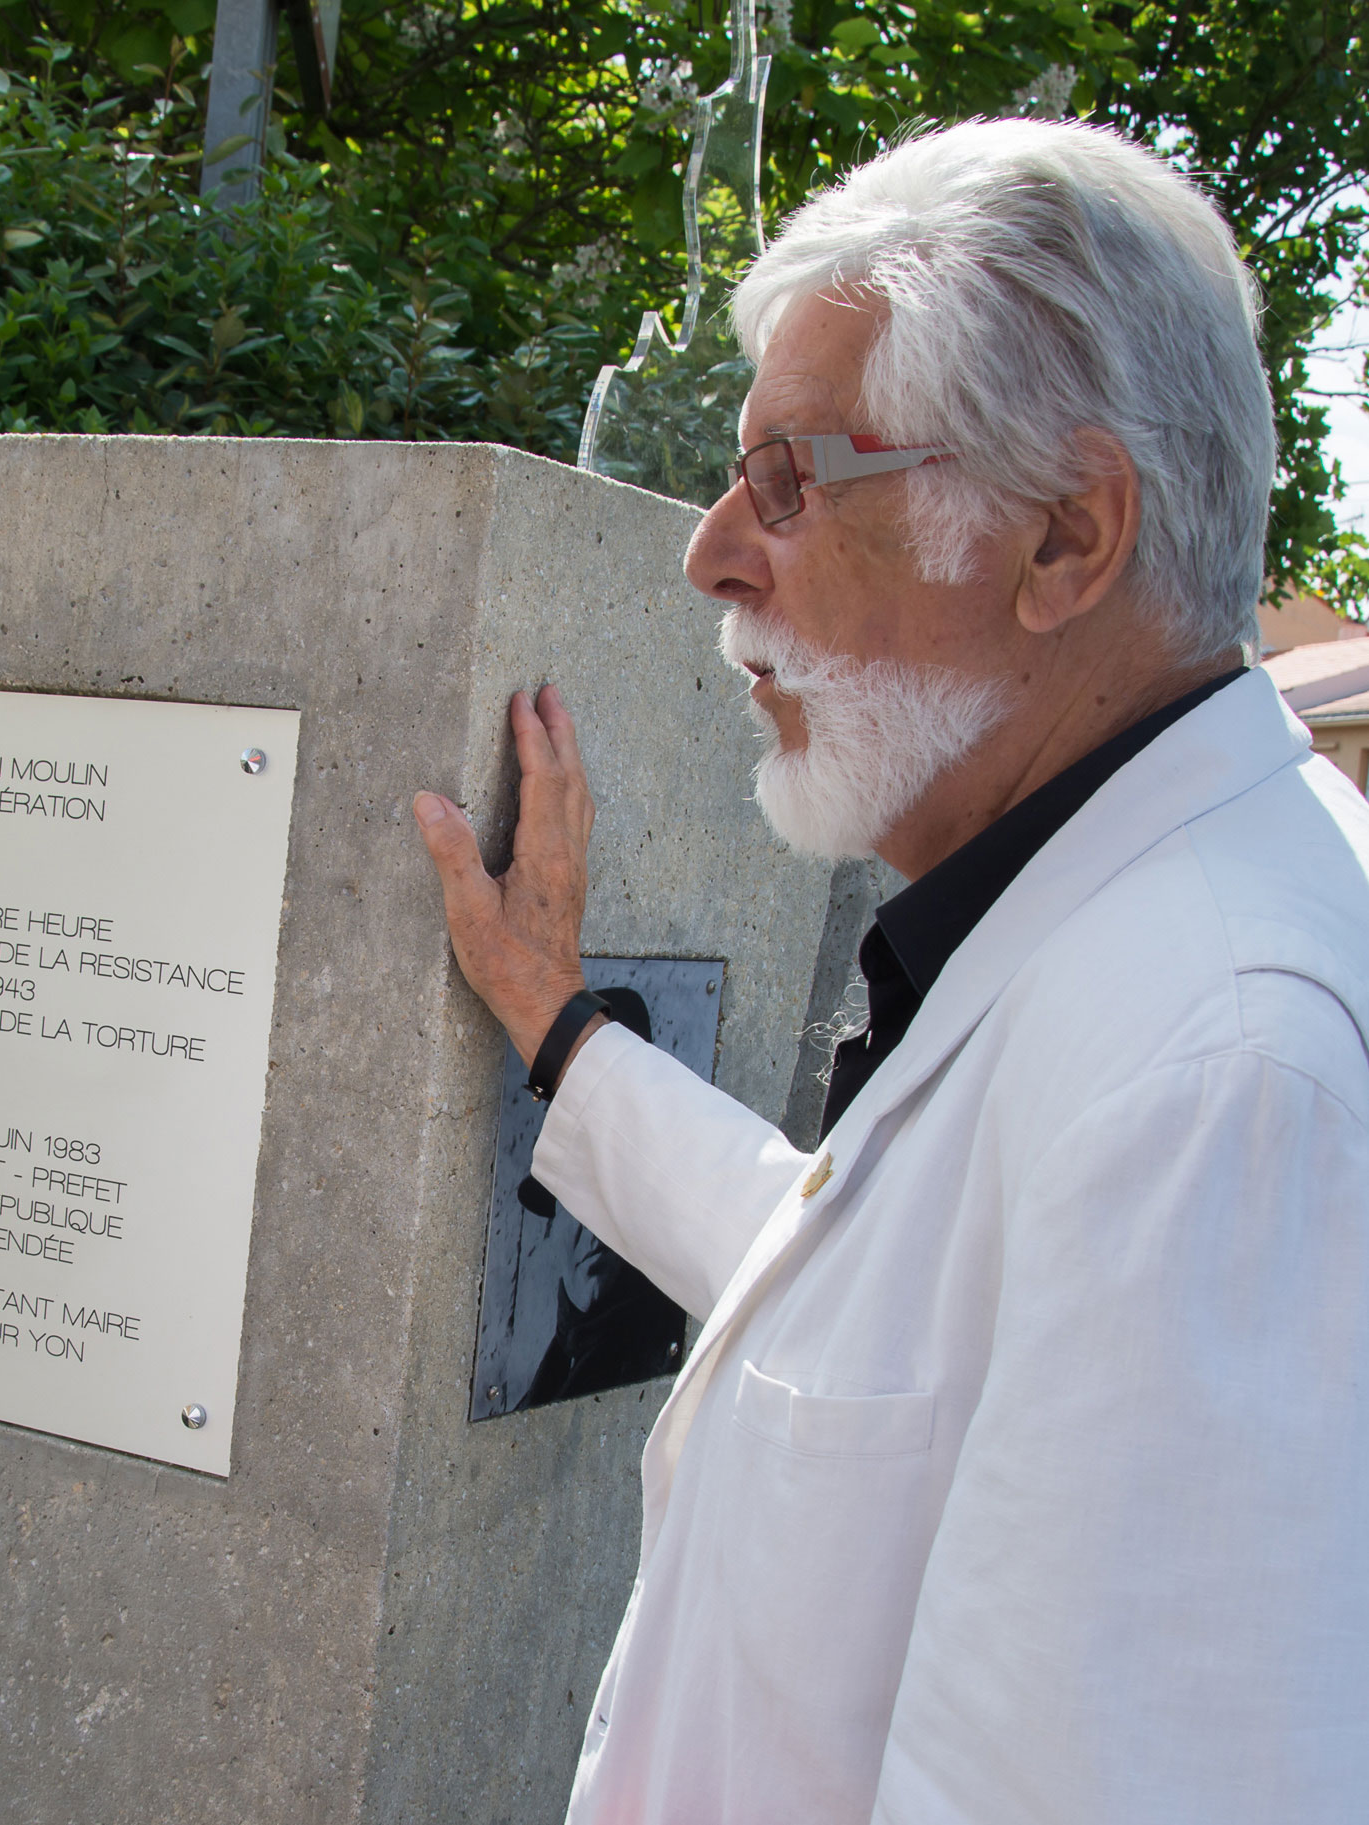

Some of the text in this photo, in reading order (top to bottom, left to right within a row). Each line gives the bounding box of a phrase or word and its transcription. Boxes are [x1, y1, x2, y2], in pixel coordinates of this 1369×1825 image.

[10, 757, 109, 788] MOULIN
[27, 910, 115, 943] HEURE
[38, 946, 71, 973] LA
[79, 951, 246, 996] RESISTANCE
[40, 1015, 73, 1042] LA
[81, 1021, 207, 1063] TORTURE
[43, 1135, 101, 1165] 1983
[31, 1166, 128, 1205] PREFET
[62, 1302, 142, 1341] MAIRE
[28, 1328, 85, 1363] YON
